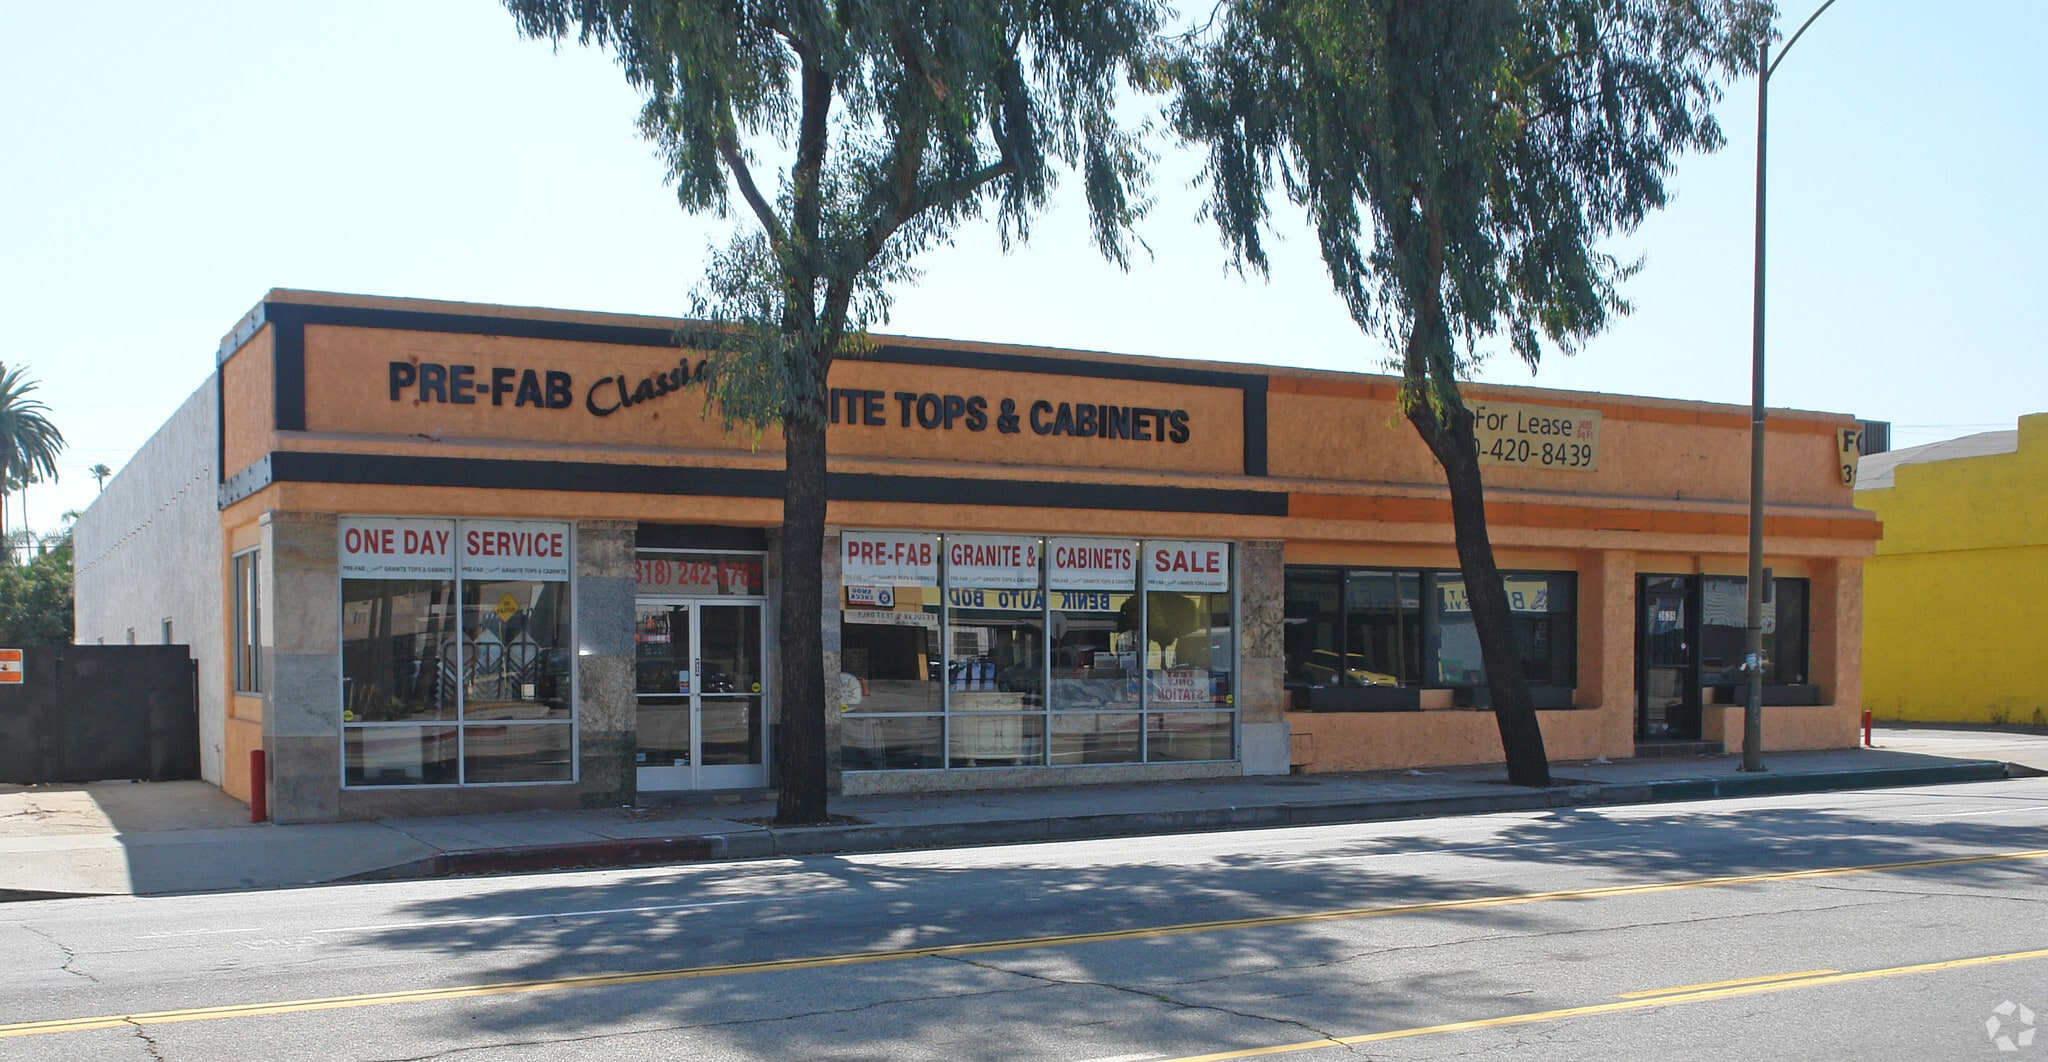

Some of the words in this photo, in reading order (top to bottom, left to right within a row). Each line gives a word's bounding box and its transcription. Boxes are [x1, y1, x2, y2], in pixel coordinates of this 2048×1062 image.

[389, 361, 572, 409] PRE-FAB
[895, 392, 987, 431] TOPS
[998, 398, 1020, 434] &
[1029, 400, 1190, 444] CABINETS
[1475, 406, 1508, 431] For
[1517, 411, 1572, 436] Lease
[345, 528, 395, 554] ONE
[404, 530, 450, 555] DAY
[466, 531, 563, 557] SERVICE
[848, 542, 932, 566] PRE-FAB
[951, 544, 1021, 567] GRANITE
[1026, 546, 1036, 567] &
[1056, 547, 1131, 570] CABINETS
[1155, 550, 1220, 573] SALE
